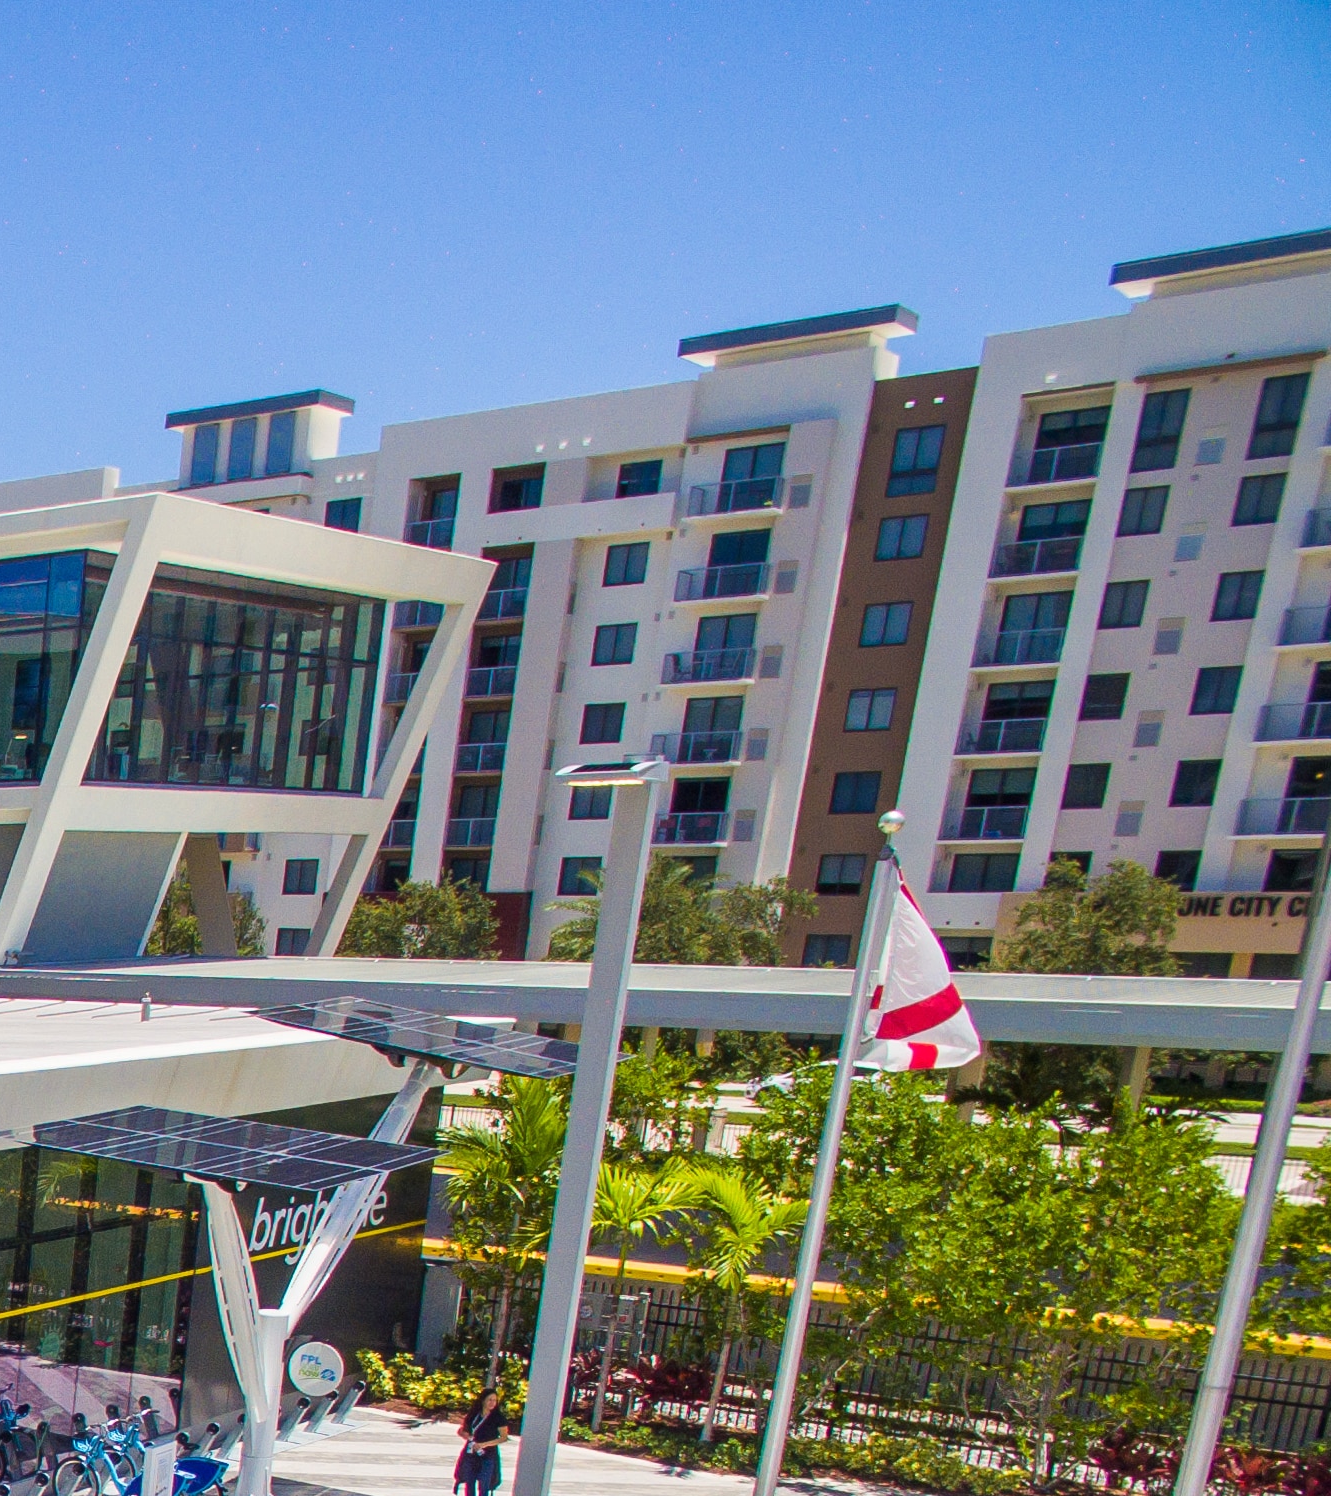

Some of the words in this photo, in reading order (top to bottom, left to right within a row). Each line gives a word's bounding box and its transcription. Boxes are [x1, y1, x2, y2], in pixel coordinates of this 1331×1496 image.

[1228, 896, 1283, 917] CITY
[249, 1190, 389, 1266] brighe
[300, 1354, 322, 1365] FPL
